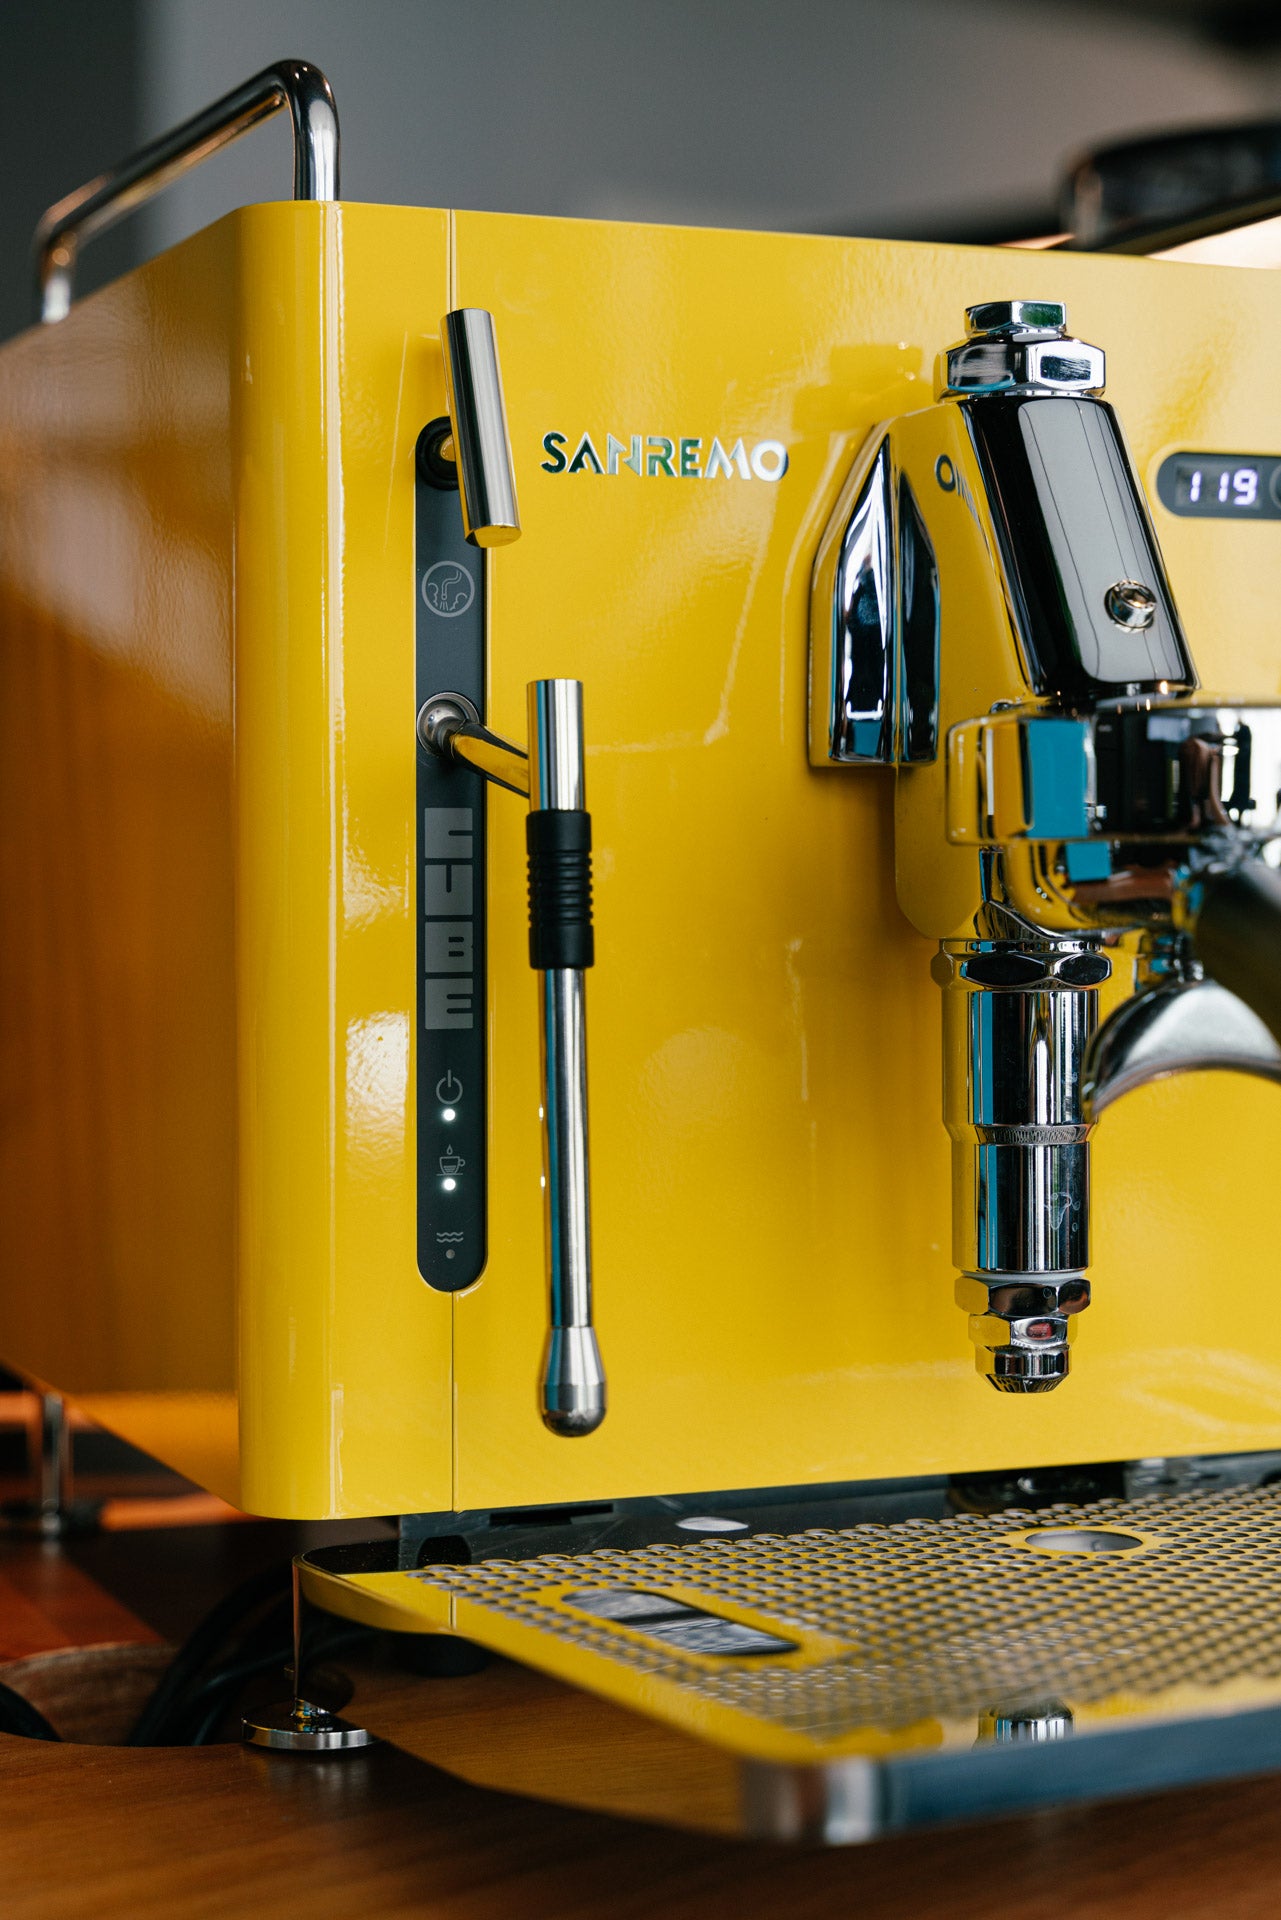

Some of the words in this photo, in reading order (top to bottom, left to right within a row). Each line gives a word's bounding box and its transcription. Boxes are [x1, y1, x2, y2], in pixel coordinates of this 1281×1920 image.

[540, 431, 789, 482] SANREMO
[1189, 468, 1258, 506] 119
[424, 807, 474, 1030] CUBE
